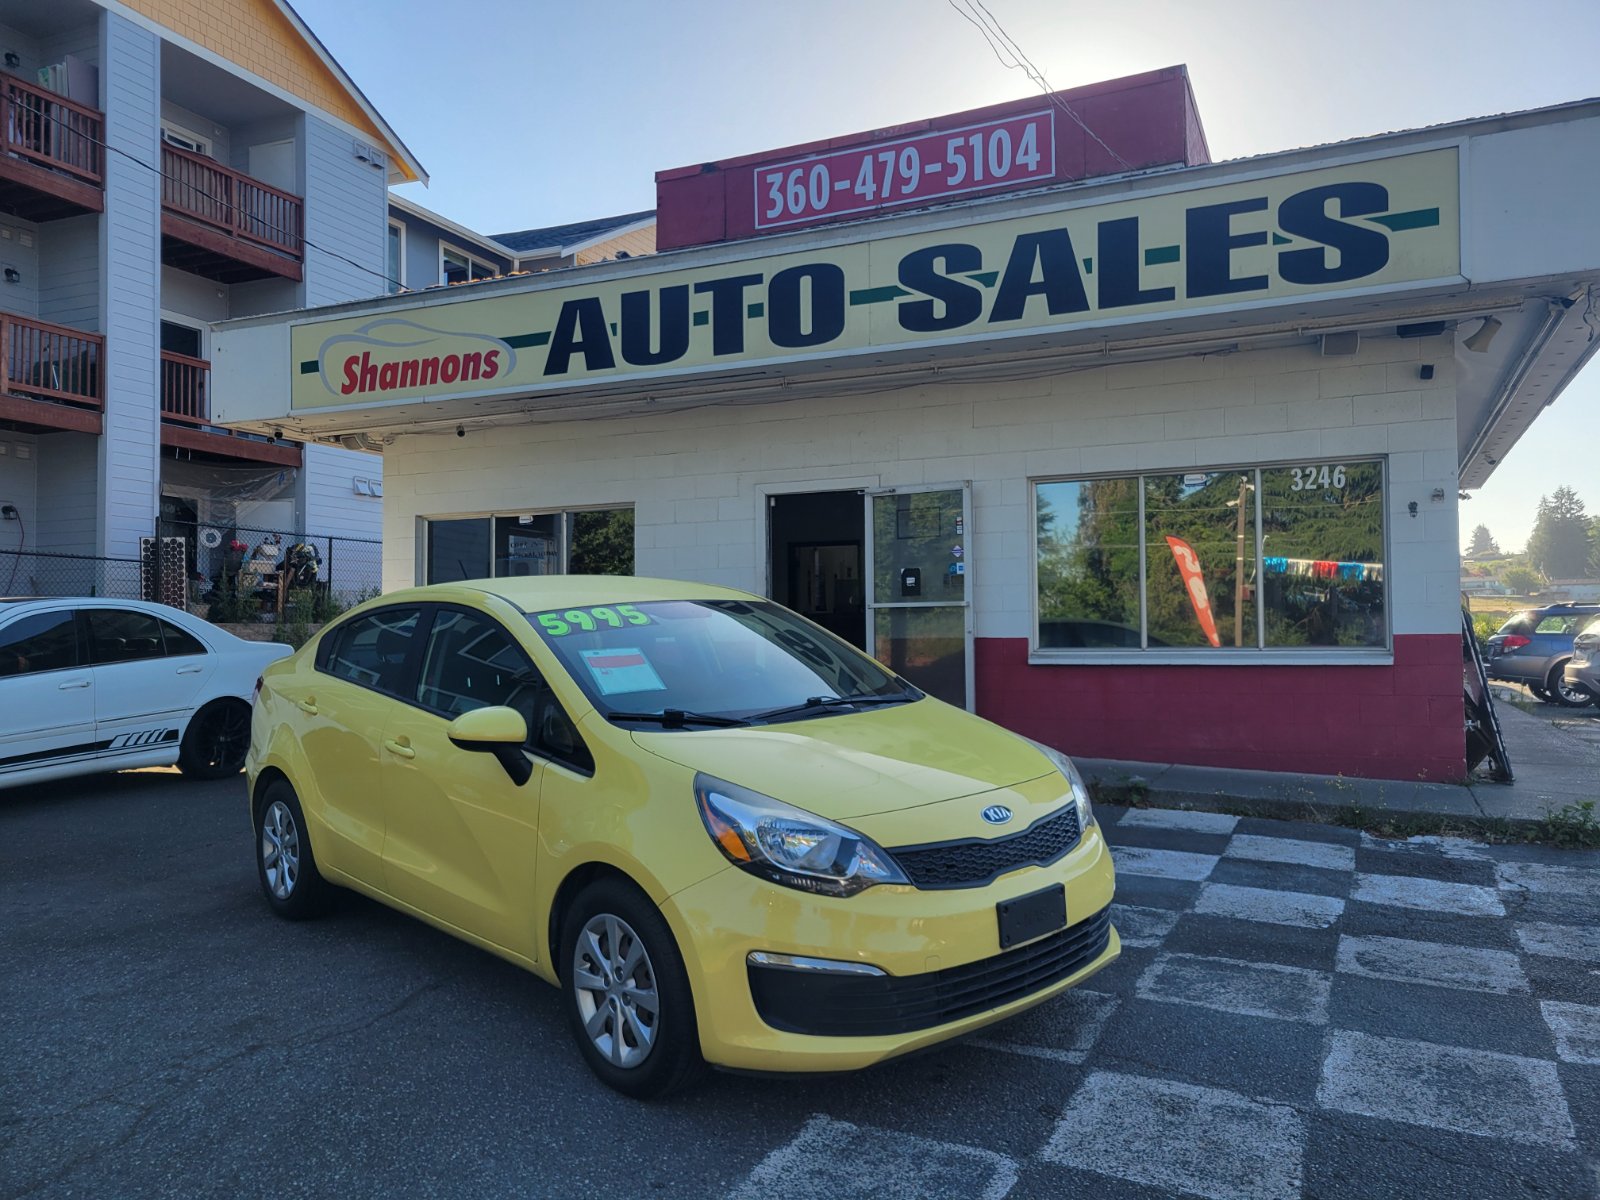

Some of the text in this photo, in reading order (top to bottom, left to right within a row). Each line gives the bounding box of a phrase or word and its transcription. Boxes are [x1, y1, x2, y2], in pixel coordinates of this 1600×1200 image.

[765, 122, 1041, 219] 360-479-5104
[341, 181, 1389, 395] Shannons AUTO SALES
[1290, 465, 1346, 491] 3246
[537, 604, 651, 636] 5995
[985, 806, 1011, 821] KIA
